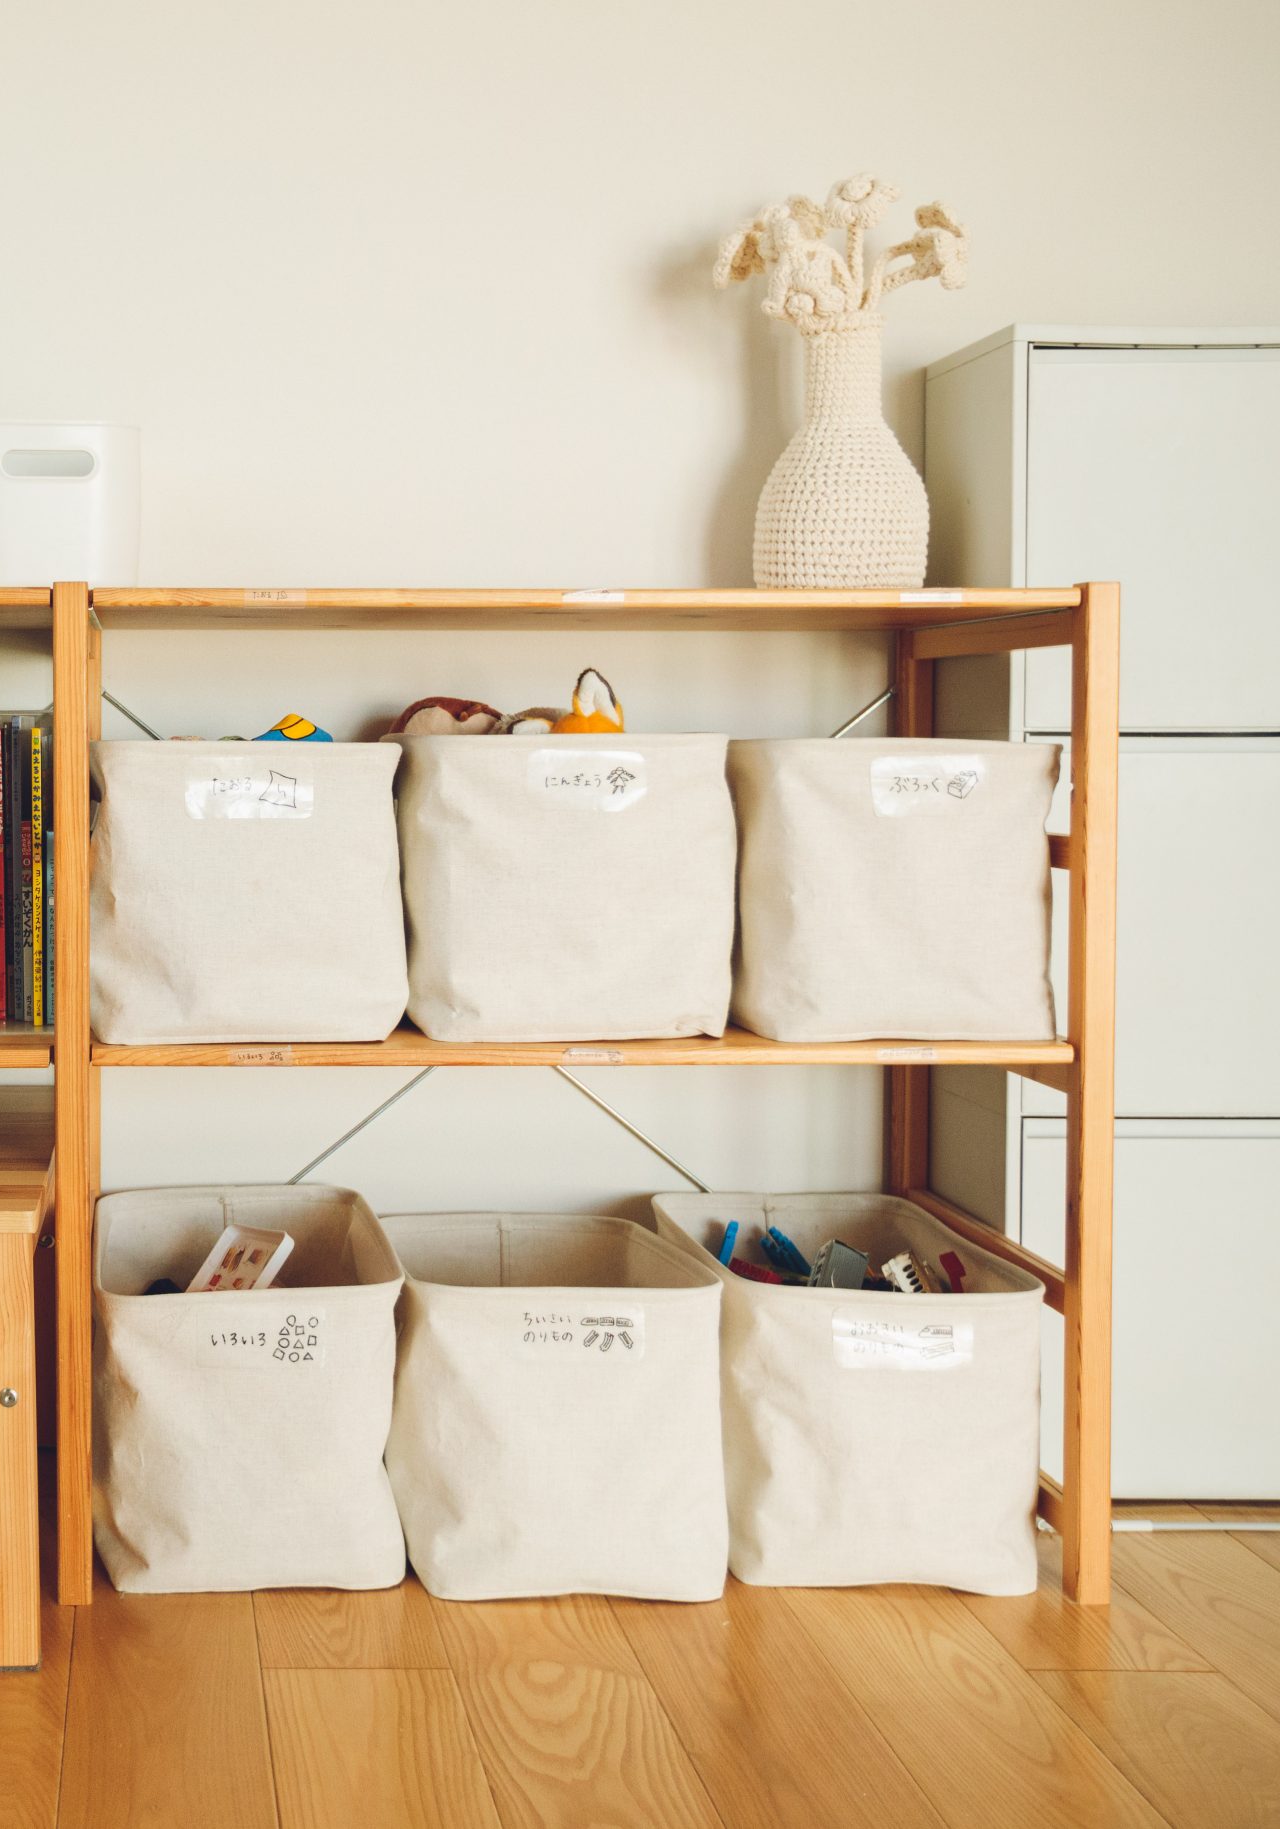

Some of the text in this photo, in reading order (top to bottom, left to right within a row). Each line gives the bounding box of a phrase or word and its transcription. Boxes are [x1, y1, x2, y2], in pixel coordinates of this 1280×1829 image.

[545, 772, 602, 788] にんぎょう
[889, 776, 940, 793] ぶろっく
[32, 748, 42, 849] みえるとかみえないとか
[22, 889, 33, 949] すいぞくかん
[523, 1312, 571, 1326] ちいさい
[211, 1332, 266, 1347] いろいろ
[523, 1331, 573, 1343] のりもの
